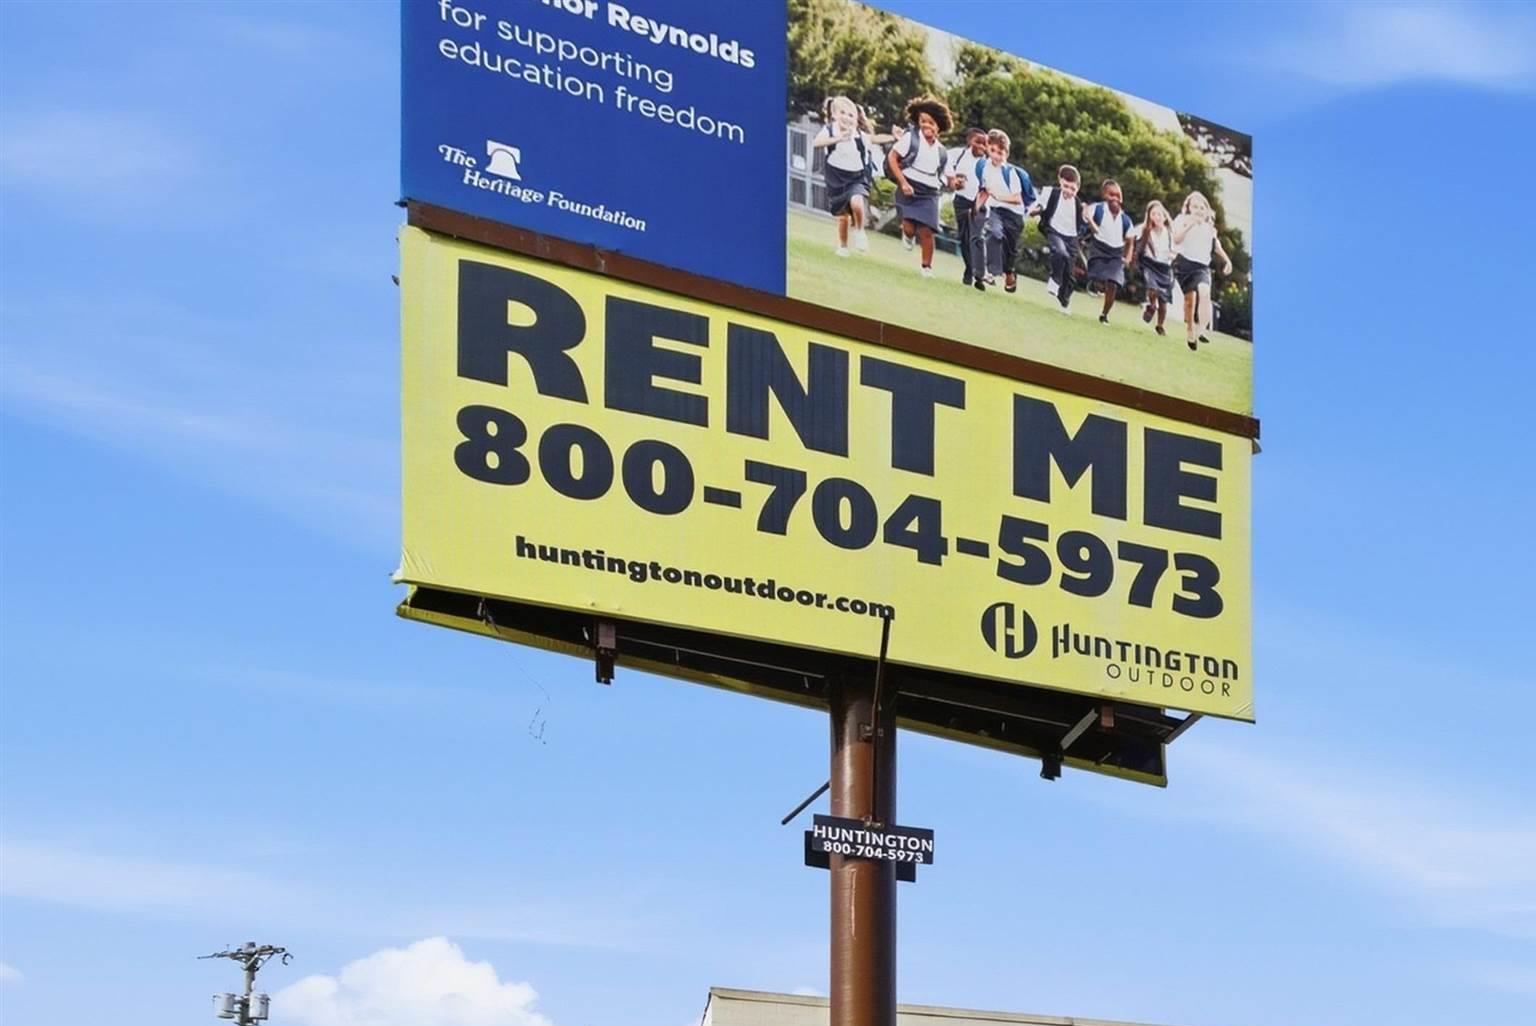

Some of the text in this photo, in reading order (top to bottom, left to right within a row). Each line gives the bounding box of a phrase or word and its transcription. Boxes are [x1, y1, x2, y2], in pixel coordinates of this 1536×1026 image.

[497, 19, 674, 94] supporting
[608, 3, 755, 69] Reynolds
[438, 36, 745, 145] education freedom
[438, 144, 477, 168] The
[463, 168, 646, 232] Heritage Foundation
[457, 259, 1223, 540] RENT ME
[453, 404, 1224, 619] 800-704-5973
[515, 535, 896, 620] huntingtonoutdoor.com
[1106, 663, 1231, 697] OUTDOOR
[813, 825, 933, 852] HUNTINGTON
[823, 841, 923, 863] 800-704-5973
